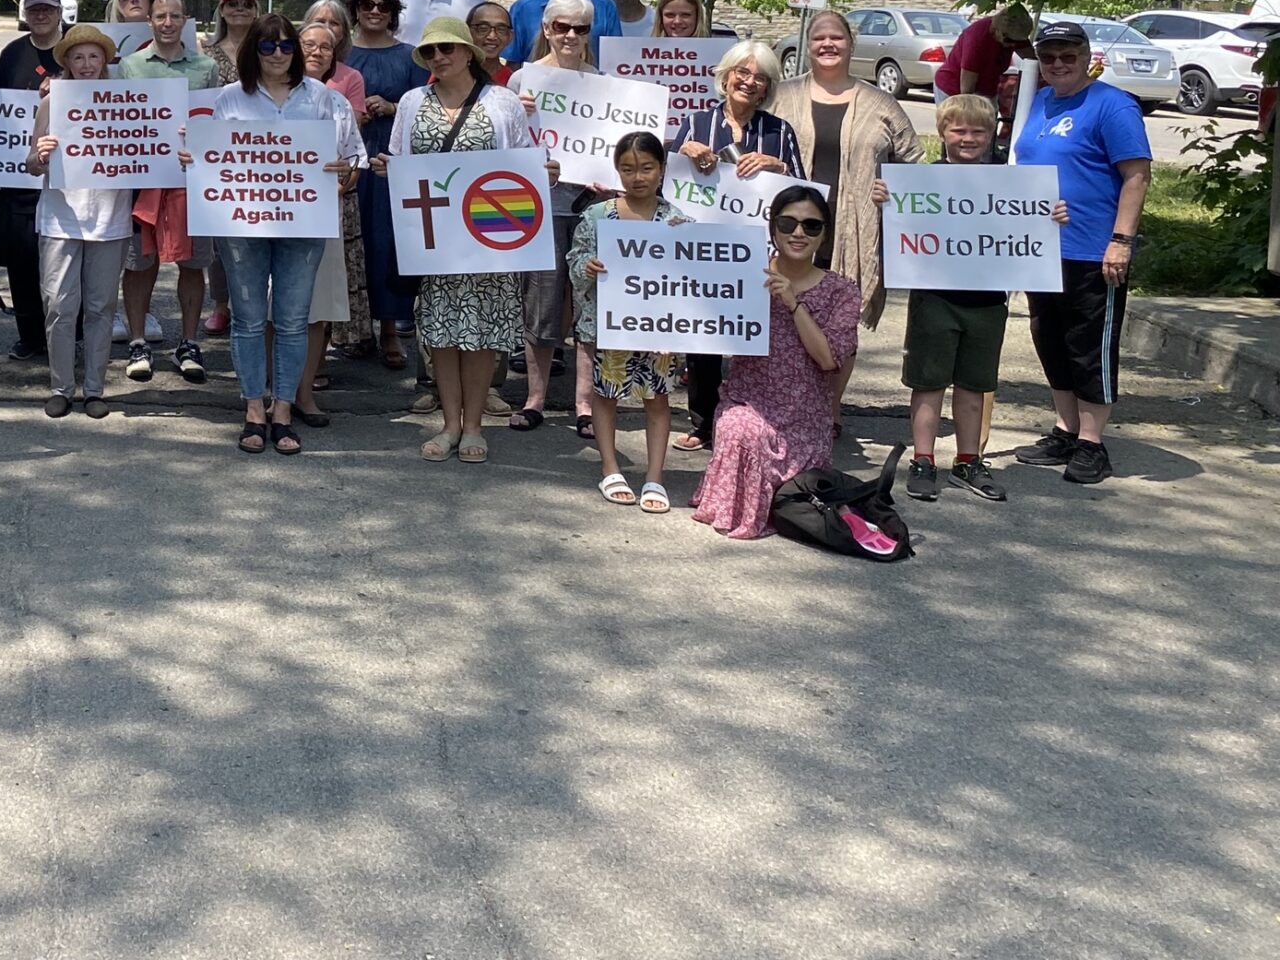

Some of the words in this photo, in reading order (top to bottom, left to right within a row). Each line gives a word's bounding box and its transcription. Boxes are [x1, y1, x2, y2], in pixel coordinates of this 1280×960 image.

[641, 47, 698, 60] Make
[92, 90, 148, 104] Make
[67, 107, 172, 122] CATHOLIC
[570, 99, 594, 119] to
[597, 102, 659, 128] Jesus
[81, 125, 159, 139] Schools
[231, 131, 292, 145] Make
[66, 142, 171, 157] CATHOLIC
[562, 135, 586, 154] to
[204, 150, 319, 165] CATHOLIC
[91, 160, 149, 177] Again
[219, 169, 305, 183] Schools
[203, 188, 318, 203] CATHOLIC
[672, 178, 717, 208] YES
[720, 192, 744, 214] to
[891, 192, 942, 215] YES
[947, 196, 975, 215] to
[979, 193, 1051, 216] Jesus
[231, 206, 294, 225] Again
[617, 238, 665, 260] We
[674, 241, 751, 263] NEED
[900, 233, 940, 256] NO
[945, 237, 973, 257] to
[978, 234, 1043, 257] Pride
[624, 274, 743, 301] Spiritual
[606, 310, 762, 341] Leadership
